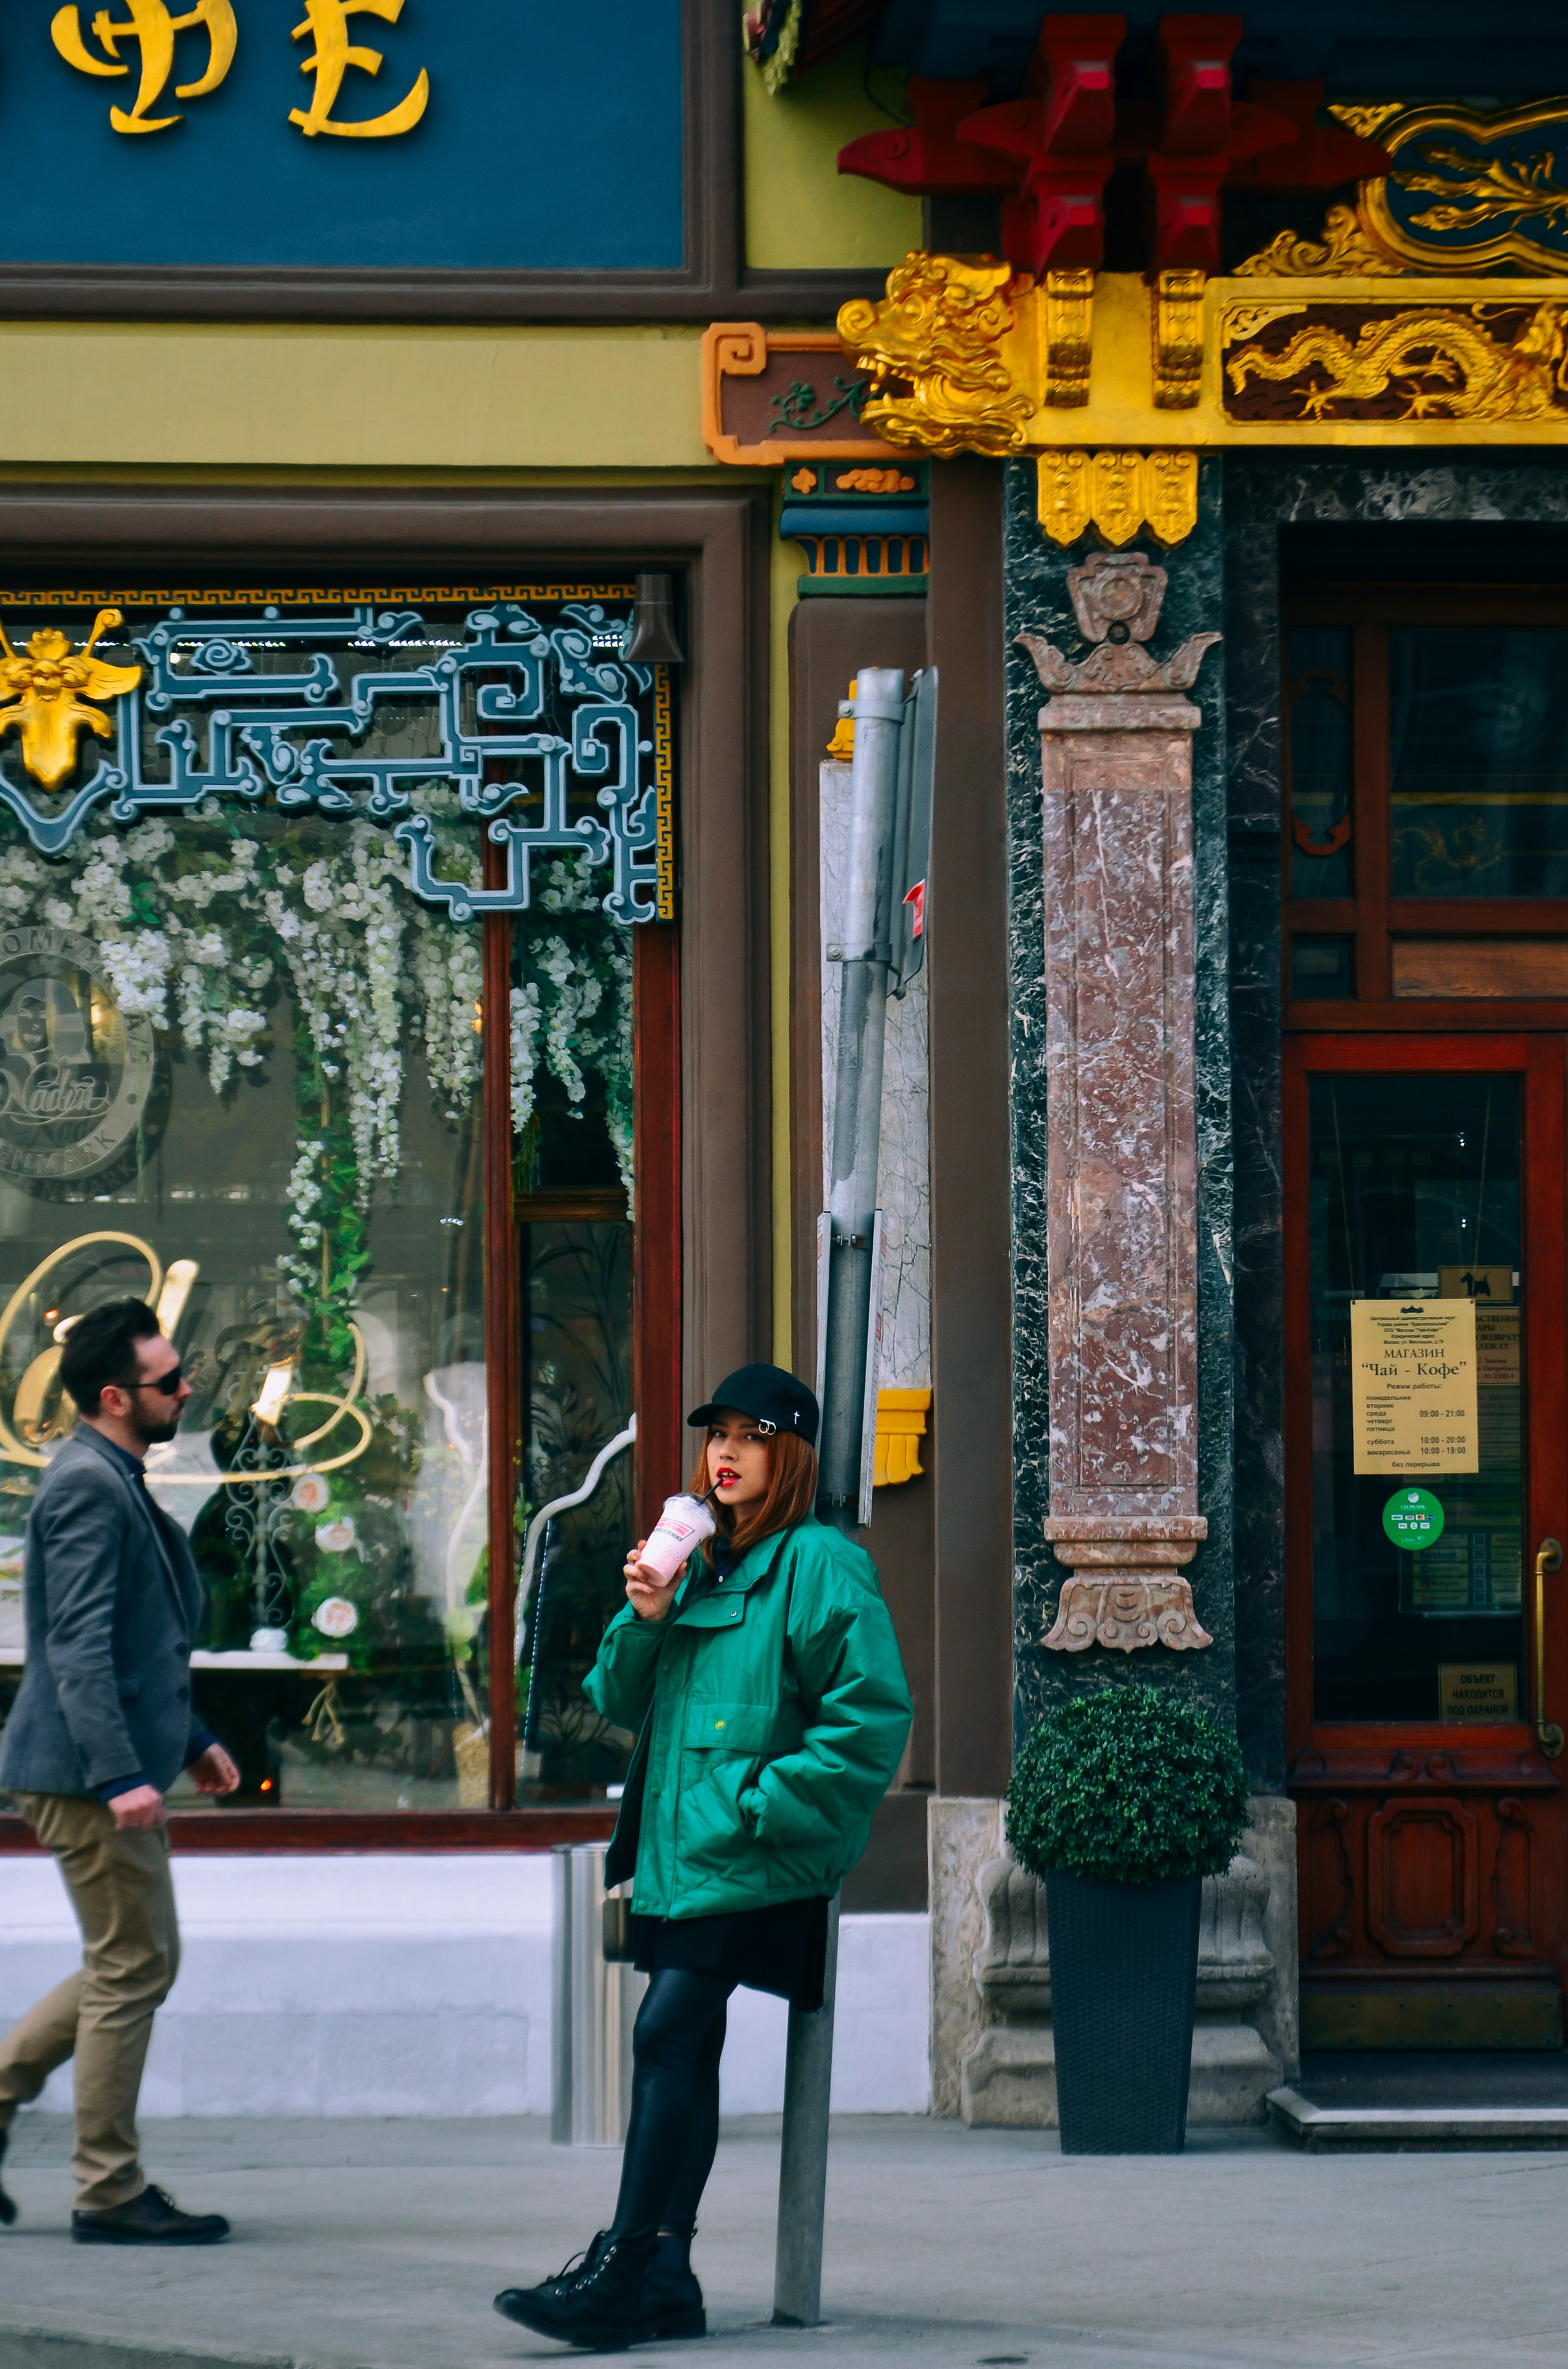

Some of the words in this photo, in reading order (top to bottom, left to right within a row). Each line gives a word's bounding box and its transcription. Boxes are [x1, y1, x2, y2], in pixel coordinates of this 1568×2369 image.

[1384, 1349, 1444, 1358] МАГАЗИН
[1461, 1674, 1494, 1684] ОБЪЕКТ
[1452, 1690, 1504, 1700] НАХОДИТСЯ
[1447, 1706, 1465, 1716] ПОД
